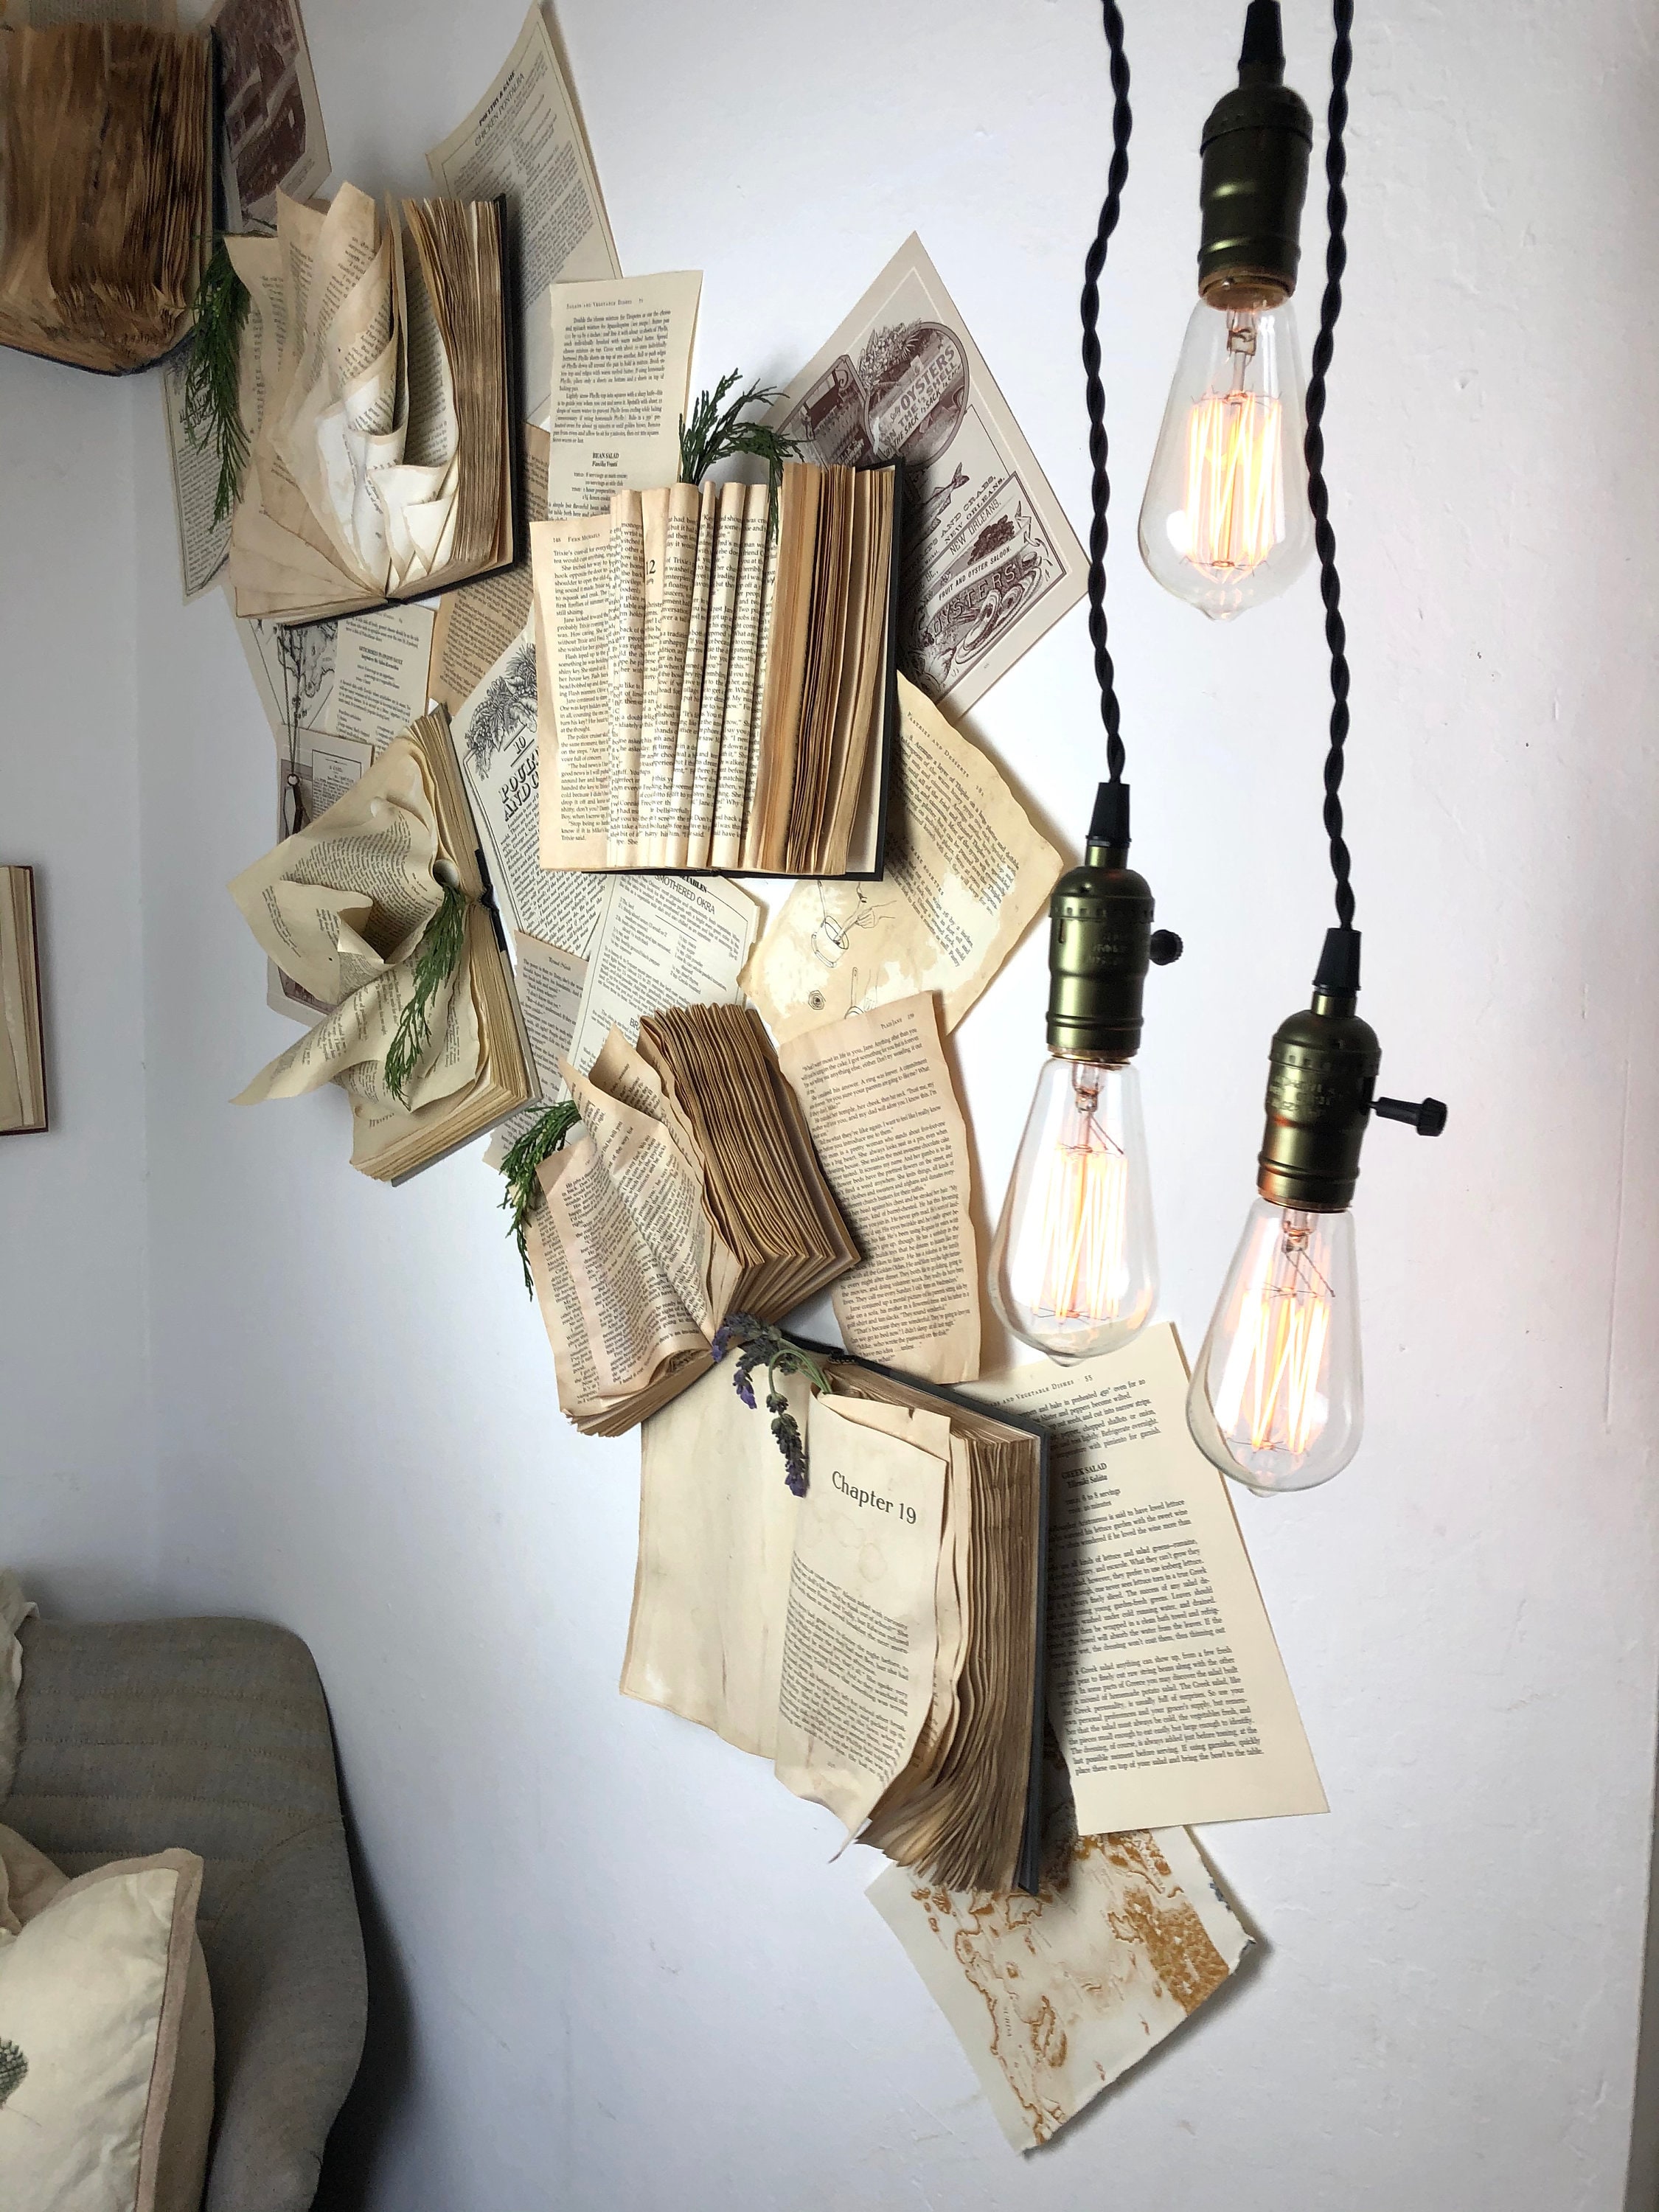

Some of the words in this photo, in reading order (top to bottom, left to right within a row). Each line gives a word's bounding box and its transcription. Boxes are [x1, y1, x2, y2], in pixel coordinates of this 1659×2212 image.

[898, 403, 919, 427] THE
[926, 361, 958, 397] SHELL
[901, 345, 955, 410] OYSTERS
[893, 430, 904, 447] THE
[904, 413, 919, 434] SACK
[925, 388, 941, 409] SACK
[941, 512, 962, 538] AND
[963, 476, 997, 512] CRABS.
[944, 521, 964, 544] NEW
[966, 477, 1006, 521] ORLEANS.
[950, 533, 966, 556] NEW
[969, 499, 1001, 535] ORLEANS.
[568, 571, 587, 580] opposite
[646, 560, 656, 574] 12
[938, 583, 953, 601] FRUIT
[956, 575, 966, 586] AND
[967, 560, 988, 579] OYSTER
[990, 548, 1012, 565] SALOON.
[575, 614, 589, 622] looked
[933, 563, 1016, 638] OYSTERS
[513, 734, 526, 754] 10
[907, 712, 931, 738] PASTRIES
[931, 739, 943, 751] AND
[944, 749, 969, 778] DESSERTS
[504, 782, 531, 822] AND
[928, 766, 937, 776] the
[937, 775, 950, 790] warm
[950, 787, 963, 805] honey
[962, 804, 975, 819] syrup
[974, 818, 983, 830] over
[654, 874, 696, 902] SMOTHERED
[696, 897, 715, 915] OKRA
[923, 865, 944, 896] ROSETTES
[821, 1057, 834, 1065] most
[610, 1130, 618, 1138] tell
[615, 1121, 623, 1131] you
[644, 1158, 652, 1167] the
[1038, 1404, 1049, 1413] and
[1127, 1380, 1136, 1388] for
[1060, 1467, 1085, 1480] GREEK
[1084, 1462, 1107, 1474] SALAD
[831, 1470, 894, 1514] Chapter
[899, 1501, 917, 1525] 19
[1129, 1760, 1136, 1768] of
[1152, 1756, 1168, 1765] salad
[1169, 1755, 1181, 1764] and
[1198, 1752, 1209, 1760] the
[1234, 1748, 1246, 1757] the
